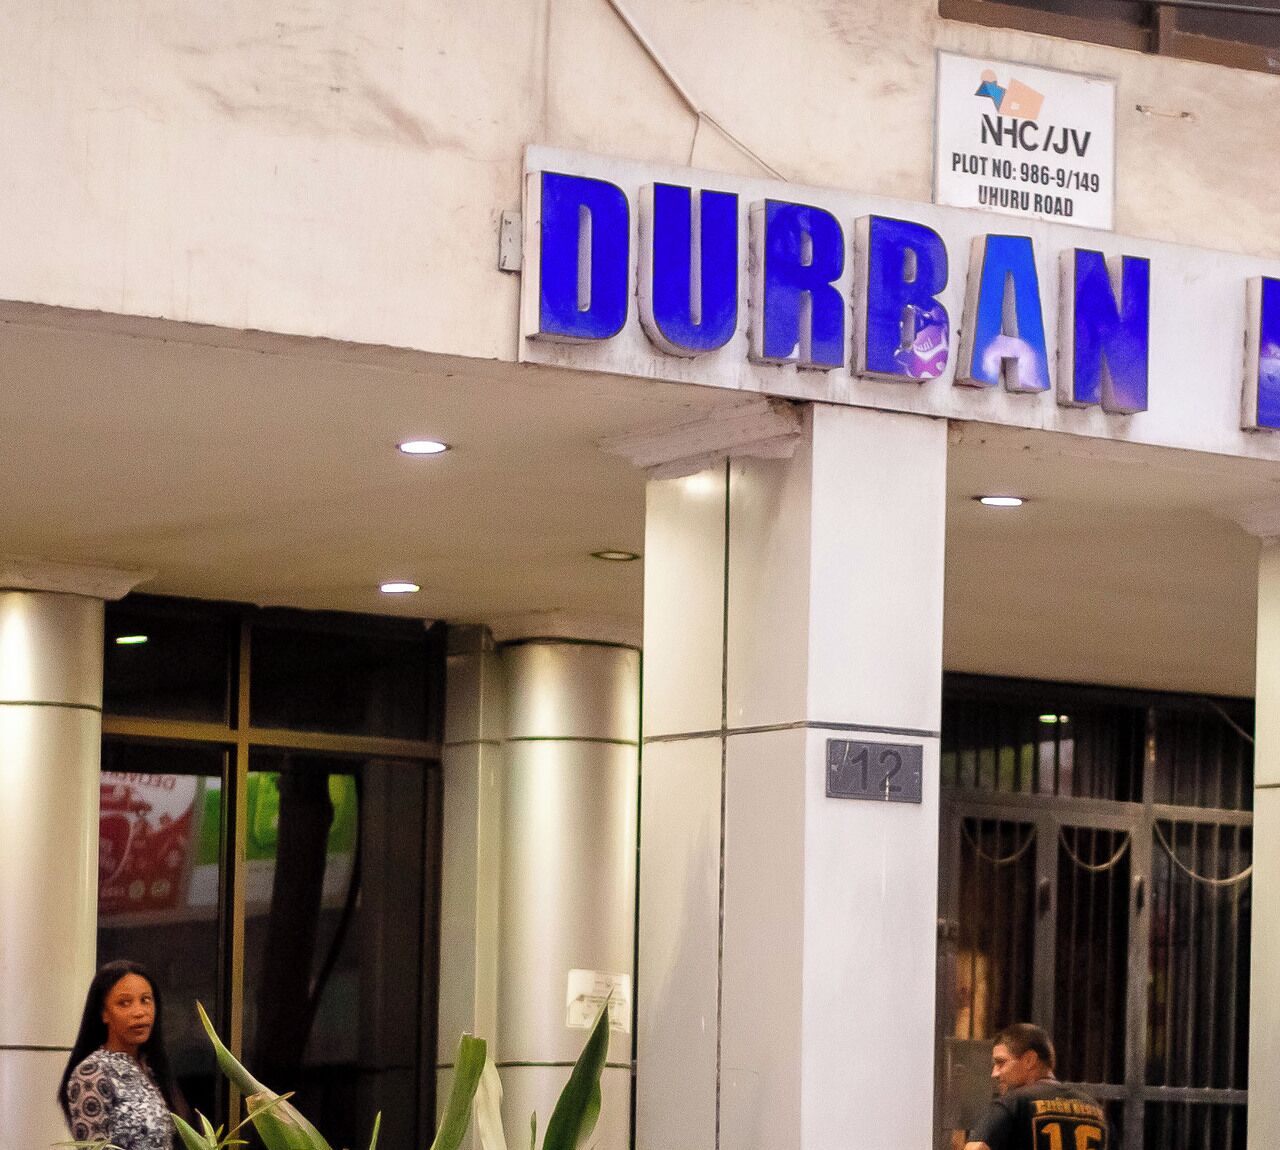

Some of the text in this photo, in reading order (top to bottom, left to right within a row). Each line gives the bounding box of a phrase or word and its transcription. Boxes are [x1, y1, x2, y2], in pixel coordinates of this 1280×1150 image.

[952, 152, 1099, 193] PLOT NO: 986-9/149
[978, 185, 1073, 217] UHURU ROAD
[528, 171, 1151, 413] DURBAN
[851, 747, 902, 792] 12
